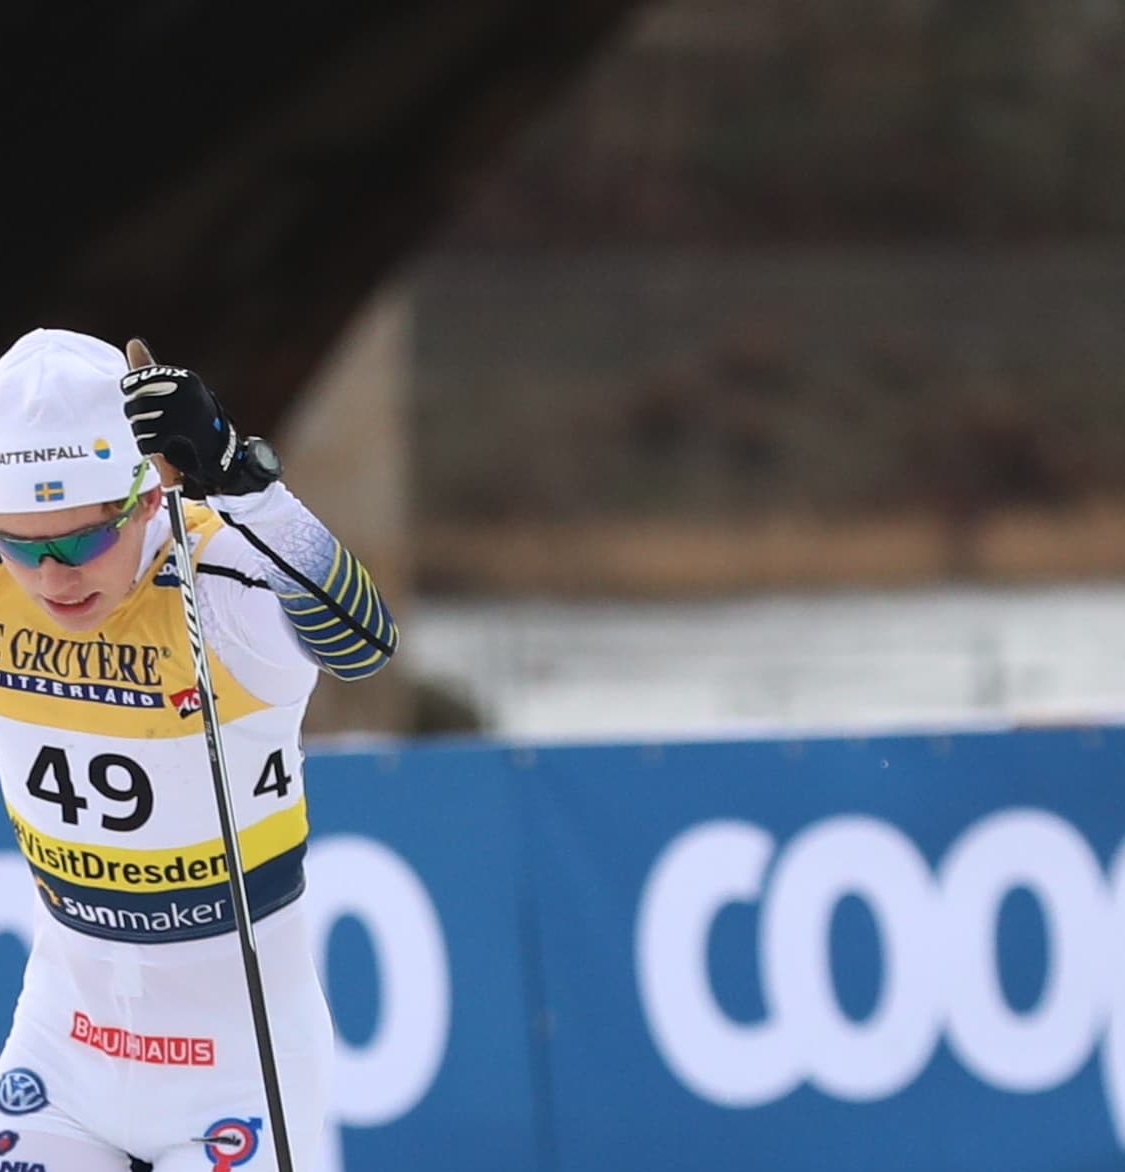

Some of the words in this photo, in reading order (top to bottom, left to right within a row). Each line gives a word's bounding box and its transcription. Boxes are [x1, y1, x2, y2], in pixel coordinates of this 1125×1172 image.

[26, 744, 154, 833] 49
[253, 748, 292, 799] 4
[62, 896, 227, 932] sunmaker
[633, 806, 1125, 1155] coo
[73, 1013, 213, 1064] BAUHAUS
